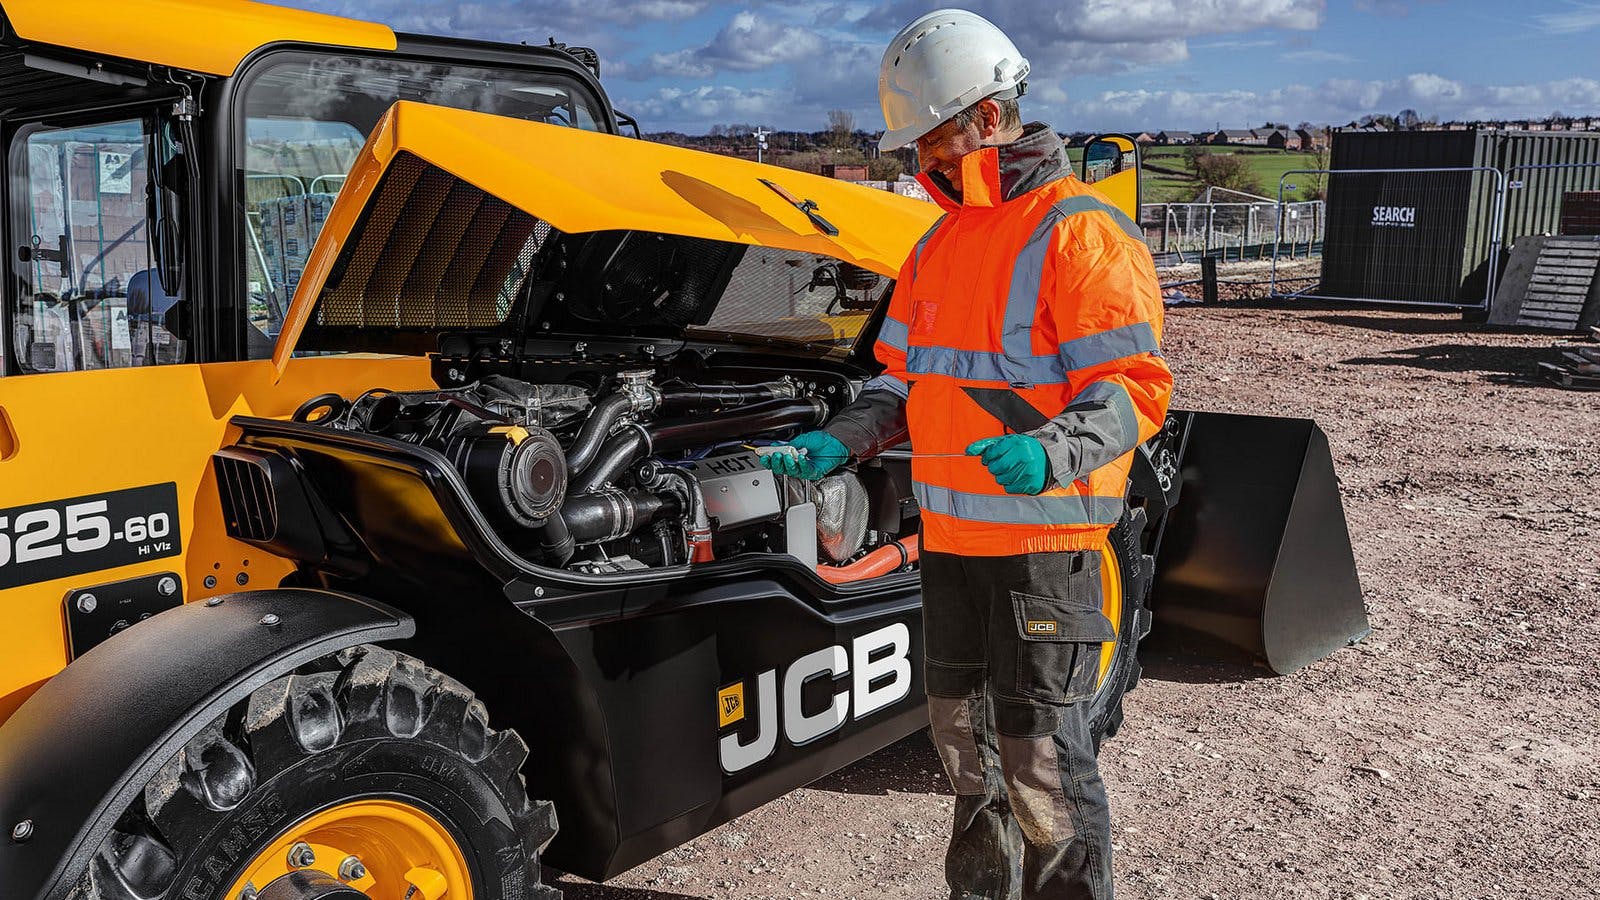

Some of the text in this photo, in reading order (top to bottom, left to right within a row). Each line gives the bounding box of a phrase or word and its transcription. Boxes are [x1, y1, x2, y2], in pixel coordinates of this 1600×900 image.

[1372, 206, 1415, 222] SEARCH
[706, 456, 756, 475] HOT
[0, 500, 170, 567] 25-60
[138, 541, 171, 556] Hi Viz
[1030, 623, 1055, 631] JCB
[720, 622, 911, 773] JCB
[723, 695, 740, 715] JCB
[183, 793, 288, 900] CAMSO
